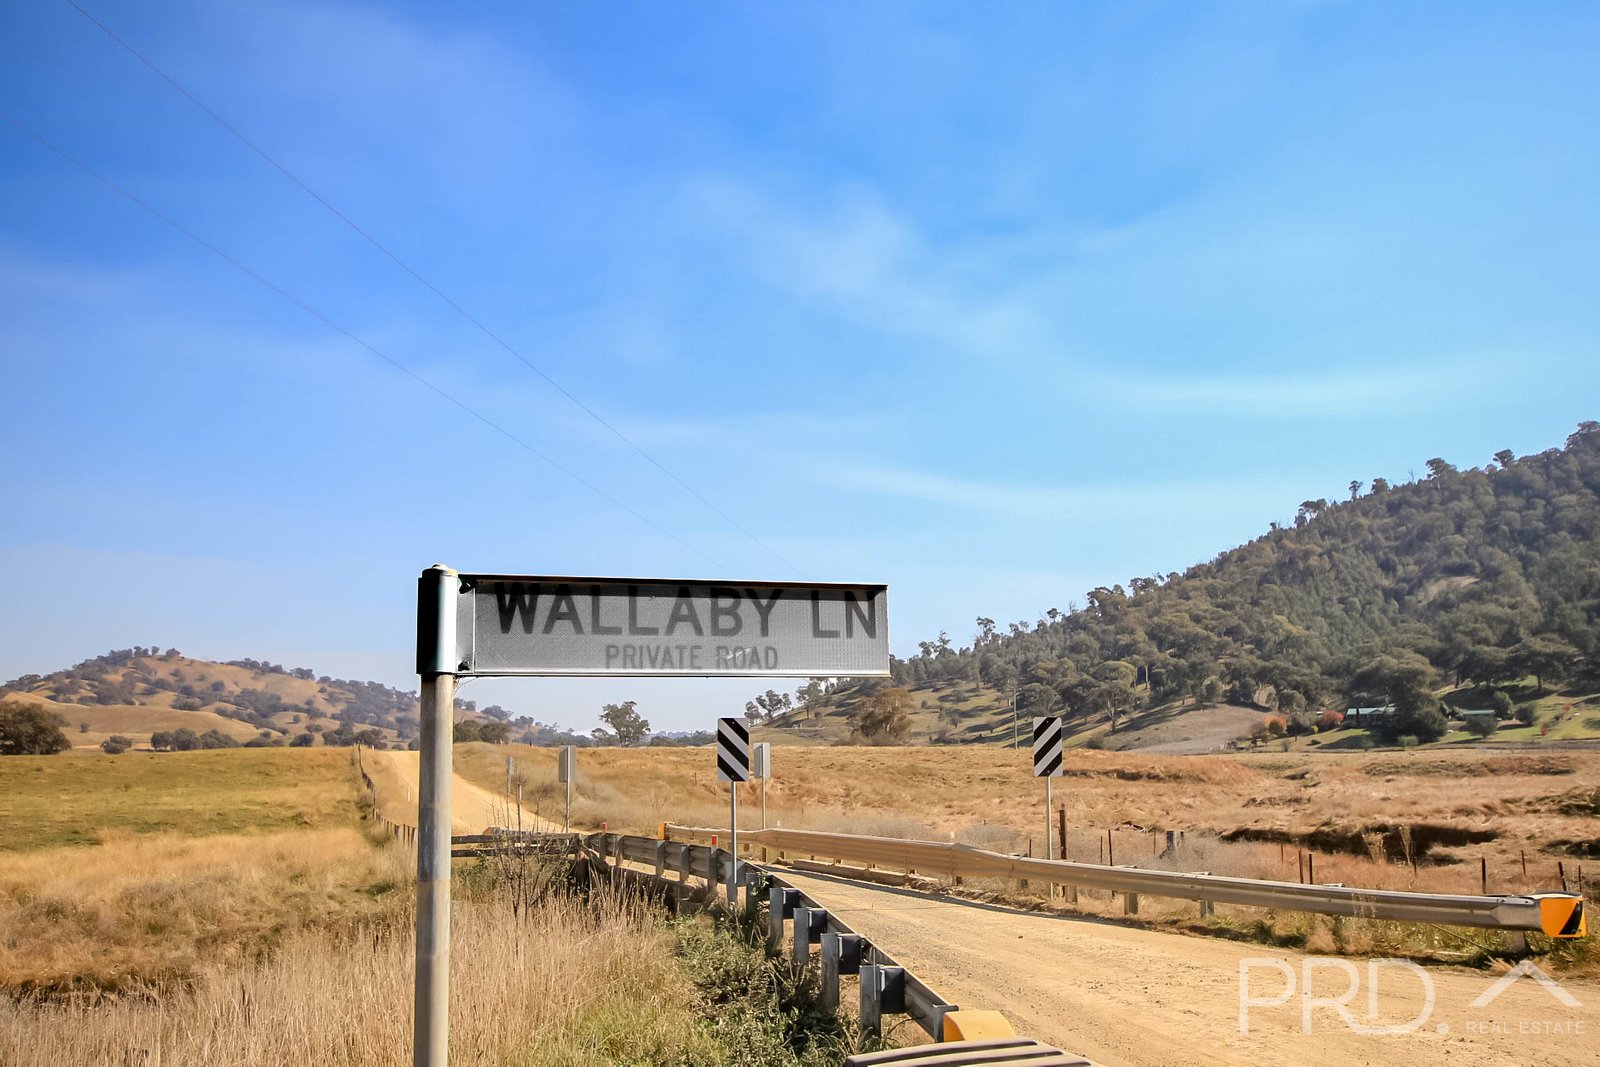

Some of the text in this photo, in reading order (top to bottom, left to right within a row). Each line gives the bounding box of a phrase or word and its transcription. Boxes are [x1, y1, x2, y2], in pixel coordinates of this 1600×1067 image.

[494, 581, 877, 640] WALLABY LN
[604, 643, 779, 671] PRIVATE ROAD
